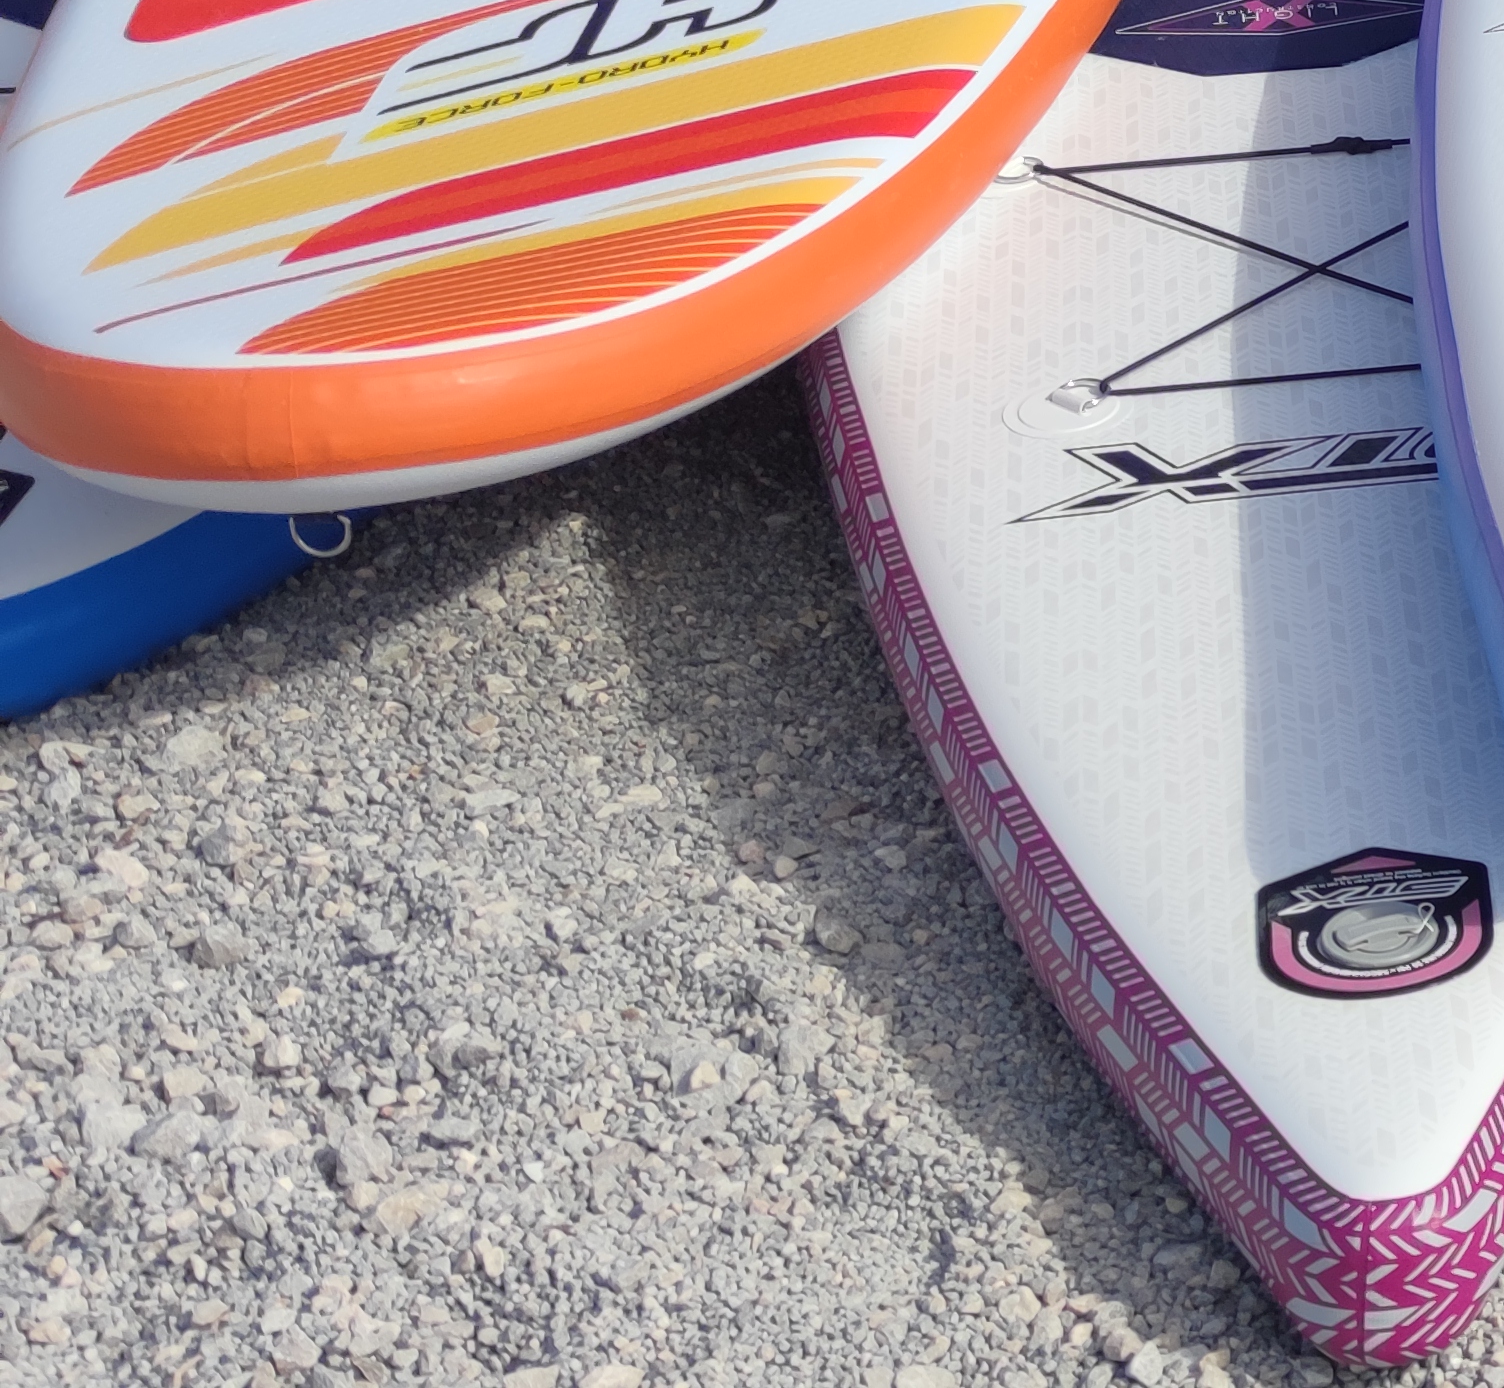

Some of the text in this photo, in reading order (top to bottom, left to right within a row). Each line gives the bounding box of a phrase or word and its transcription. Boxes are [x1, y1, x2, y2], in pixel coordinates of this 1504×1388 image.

[399, 37, 731, 132] HYDRO-FORCE
[1006, 426, 1440, 525] TX
[1277, 875, 1469, 917] STX
